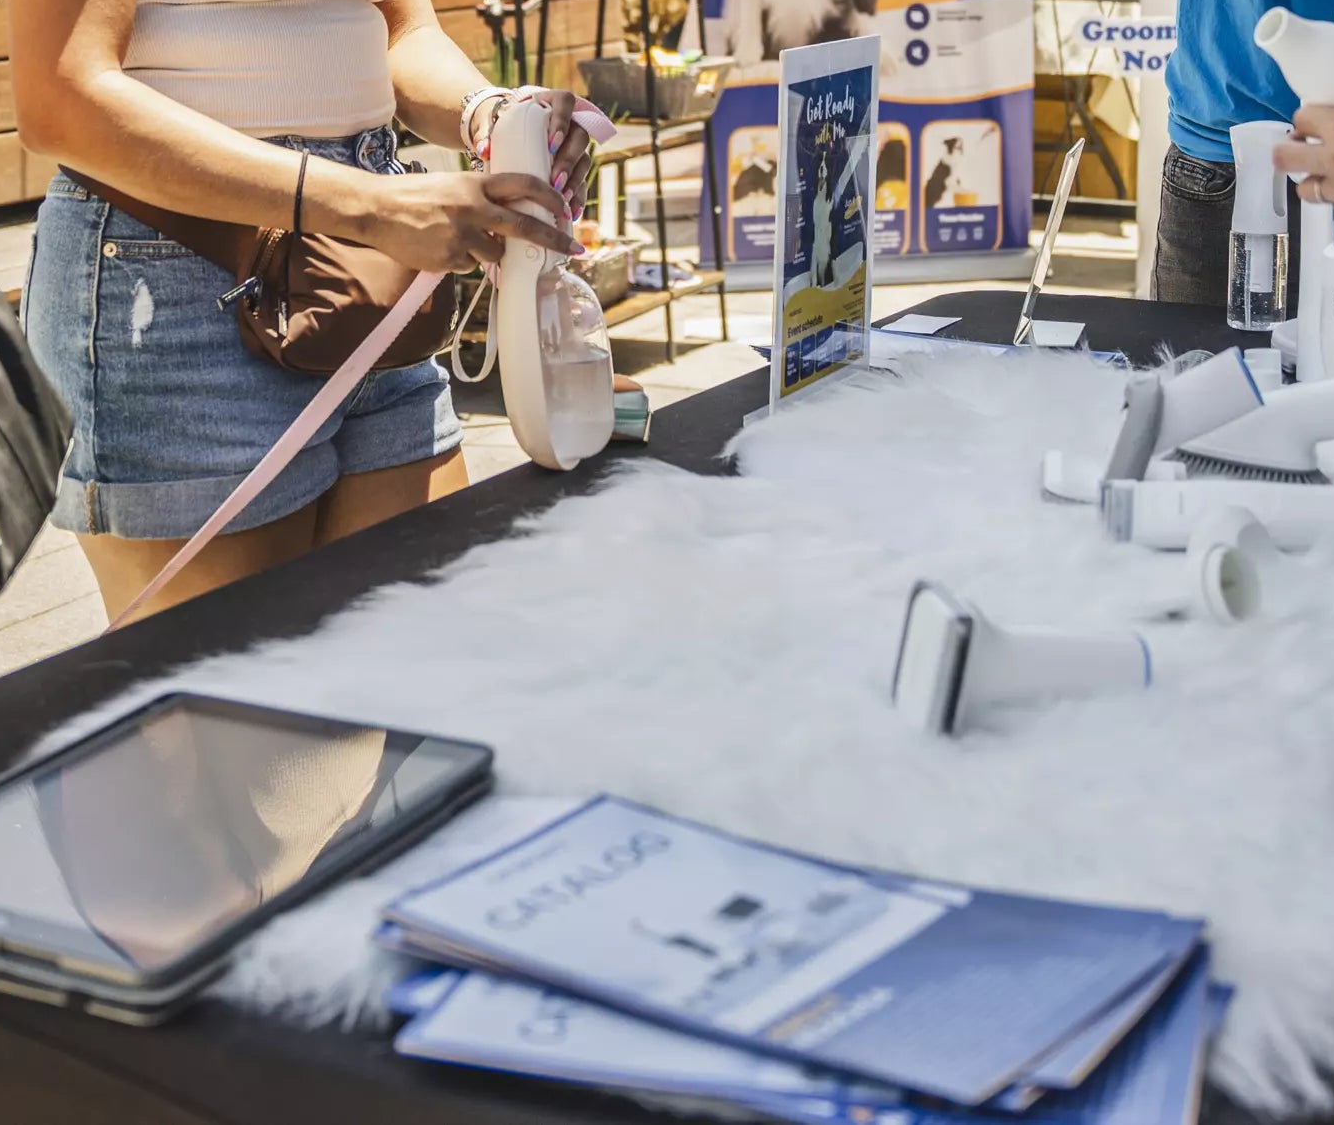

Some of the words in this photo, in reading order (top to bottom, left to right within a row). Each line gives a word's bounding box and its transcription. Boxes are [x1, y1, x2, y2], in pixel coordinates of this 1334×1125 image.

[1123, 50, 1172, 71] No
[807, 95, 824, 125] Get
[825, 84, 855, 124] Ready
[486, 831, 670, 931] CATALOG
